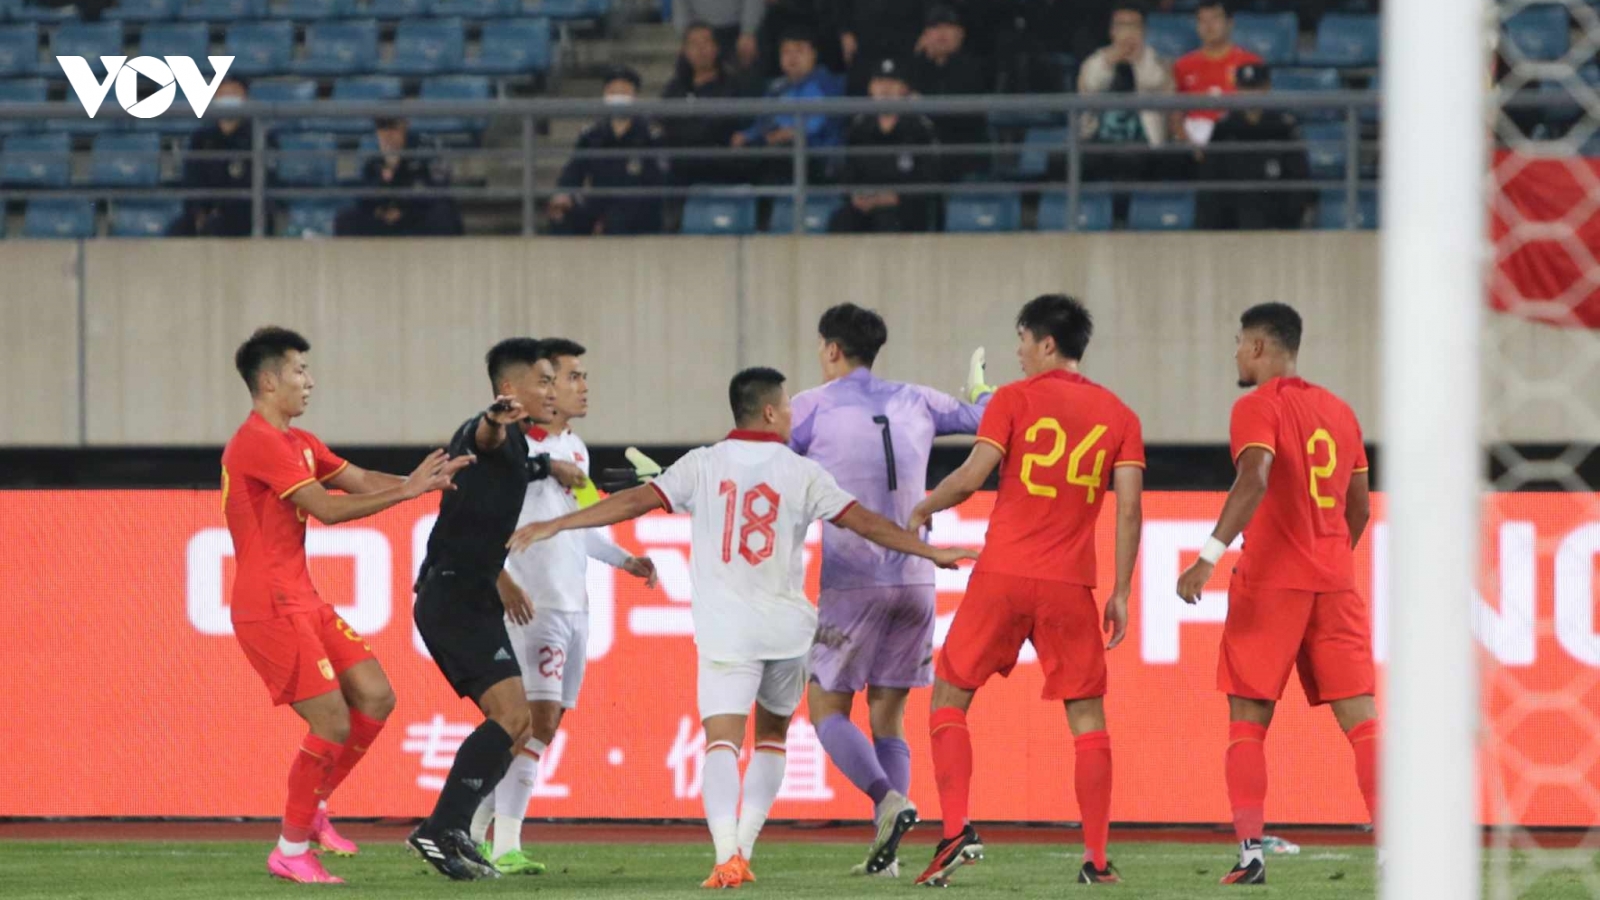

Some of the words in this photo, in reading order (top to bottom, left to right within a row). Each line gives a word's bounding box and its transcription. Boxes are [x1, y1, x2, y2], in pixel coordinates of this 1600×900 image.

[872, 415, 898, 492] 1
[1019, 416, 1109, 504] 24
[1306, 428, 1338, 508] 2
[718, 479, 781, 567] 18
